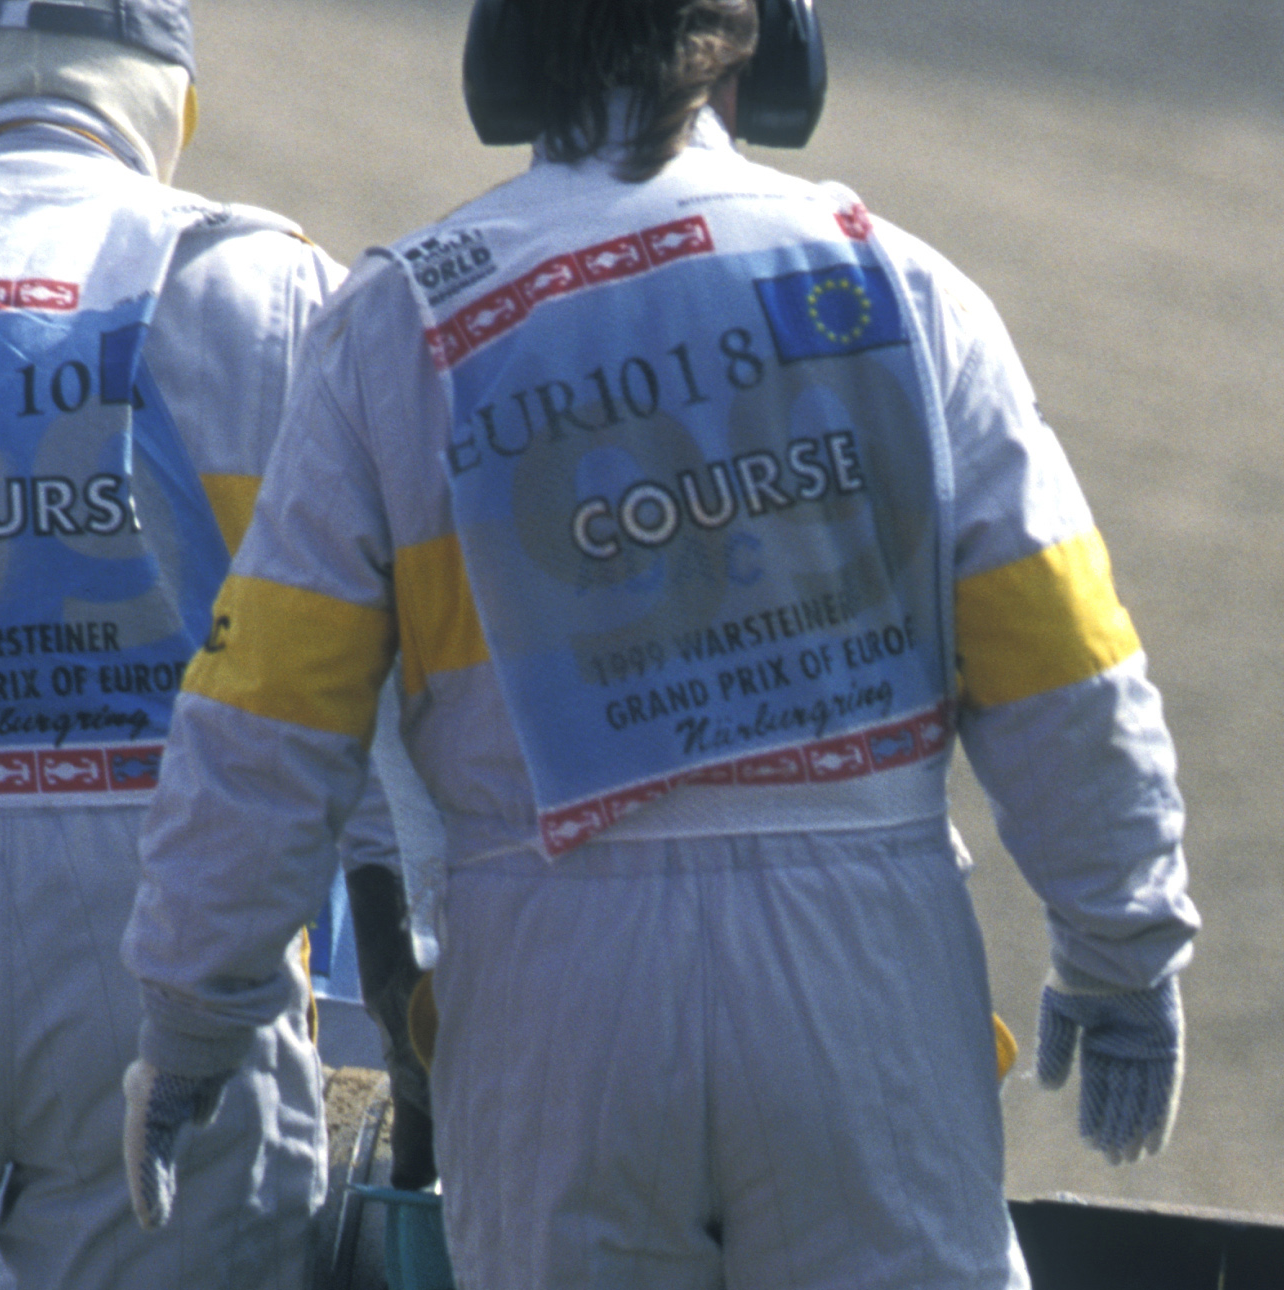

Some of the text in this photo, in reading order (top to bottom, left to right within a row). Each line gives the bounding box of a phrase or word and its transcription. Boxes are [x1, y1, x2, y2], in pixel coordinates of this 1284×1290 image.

[573, 429, 866, 559] COURSE
[51, 665, 87, 697] OF
[588, 641, 664, 686] 1999
[605, 678, 710, 731] GRAND
[717, 655, 791, 701] PRIX
[799, 644, 834, 680] OF
